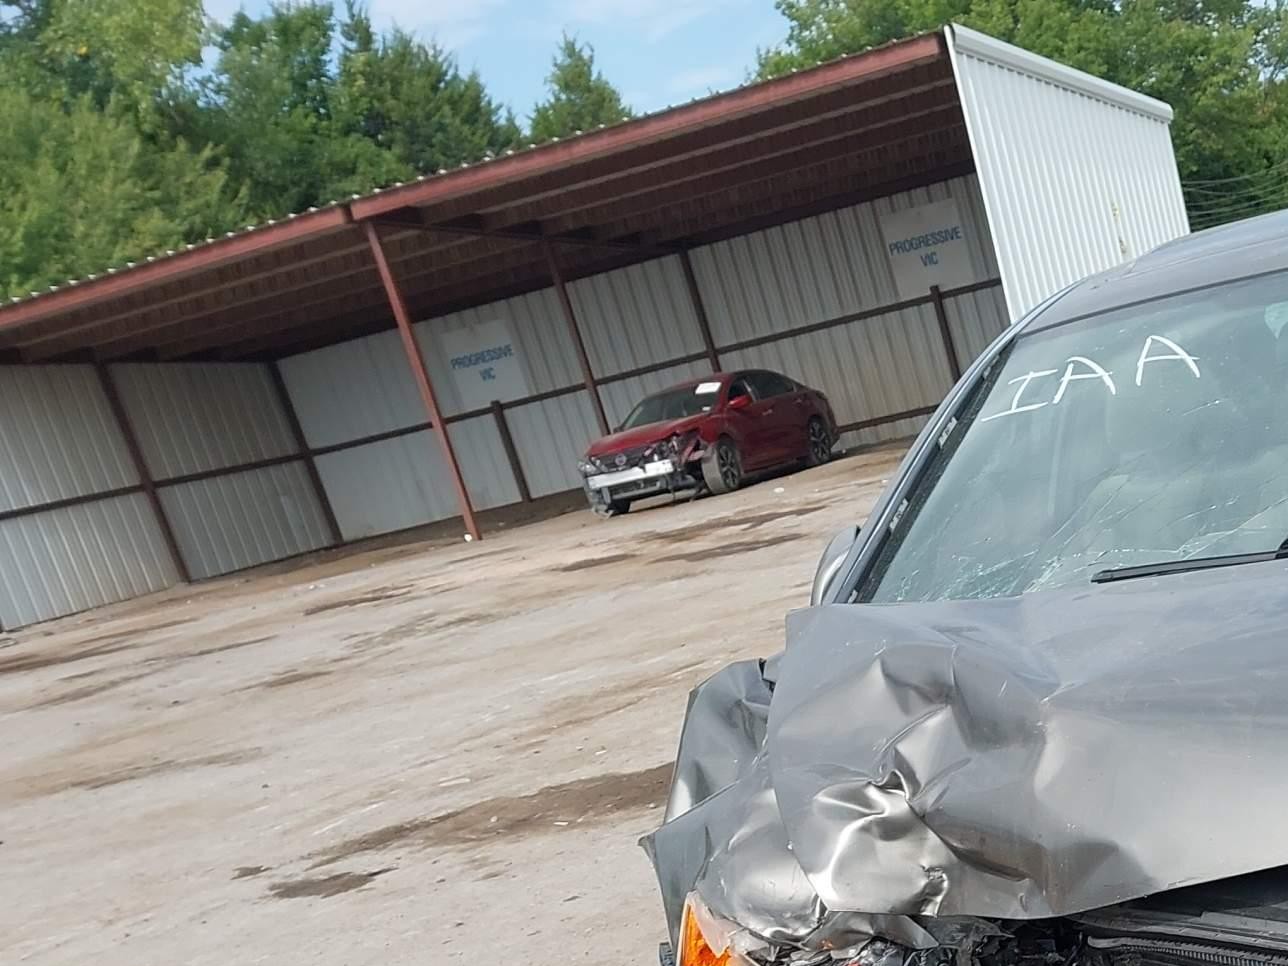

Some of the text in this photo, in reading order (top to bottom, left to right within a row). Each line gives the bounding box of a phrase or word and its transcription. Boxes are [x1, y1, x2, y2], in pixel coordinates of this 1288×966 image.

[889, 227, 962, 256] PROGRESSIVE
[920, 252, 939, 267] VIC
[450, 343, 513, 370] PROGRESSIVE
[981, 335, 1201, 422] IAA
